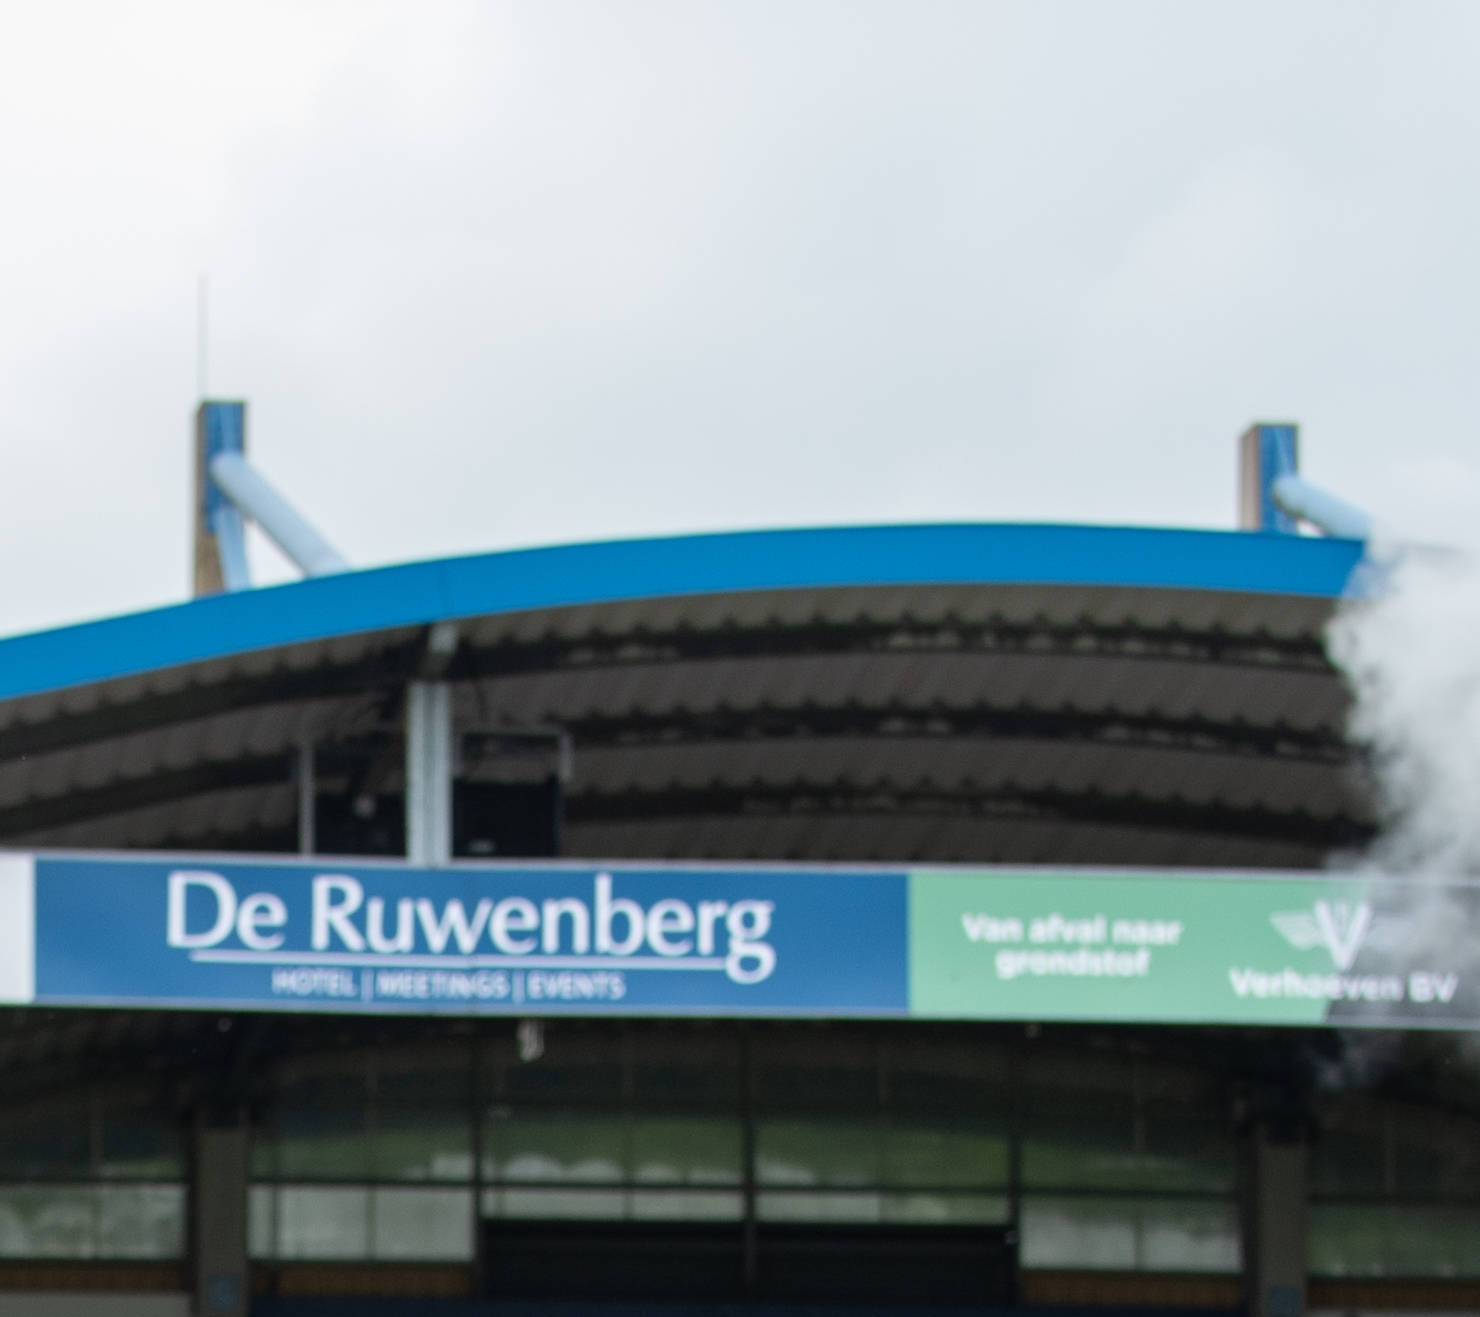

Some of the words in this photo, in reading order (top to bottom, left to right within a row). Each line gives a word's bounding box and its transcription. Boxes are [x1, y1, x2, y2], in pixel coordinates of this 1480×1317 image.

[167, 870, 289, 951] De
[311, 872, 778, 984] Ruwenberg
[961, 911, 1024, 943] Van
[1028, 911, 1107, 944] afval
[1112, 917, 1184, 945] naar
[995, 946, 1150, 980] grondstof
[272, 967, 358, 997] HOTEL
[376, 967, 510, 1000] MEETINGS
[526, 969, 627, 1000] EVENTS
[1229, 966, 1405, 1001] Verhoeven
[1408, 970, 1460, 1003] BV
